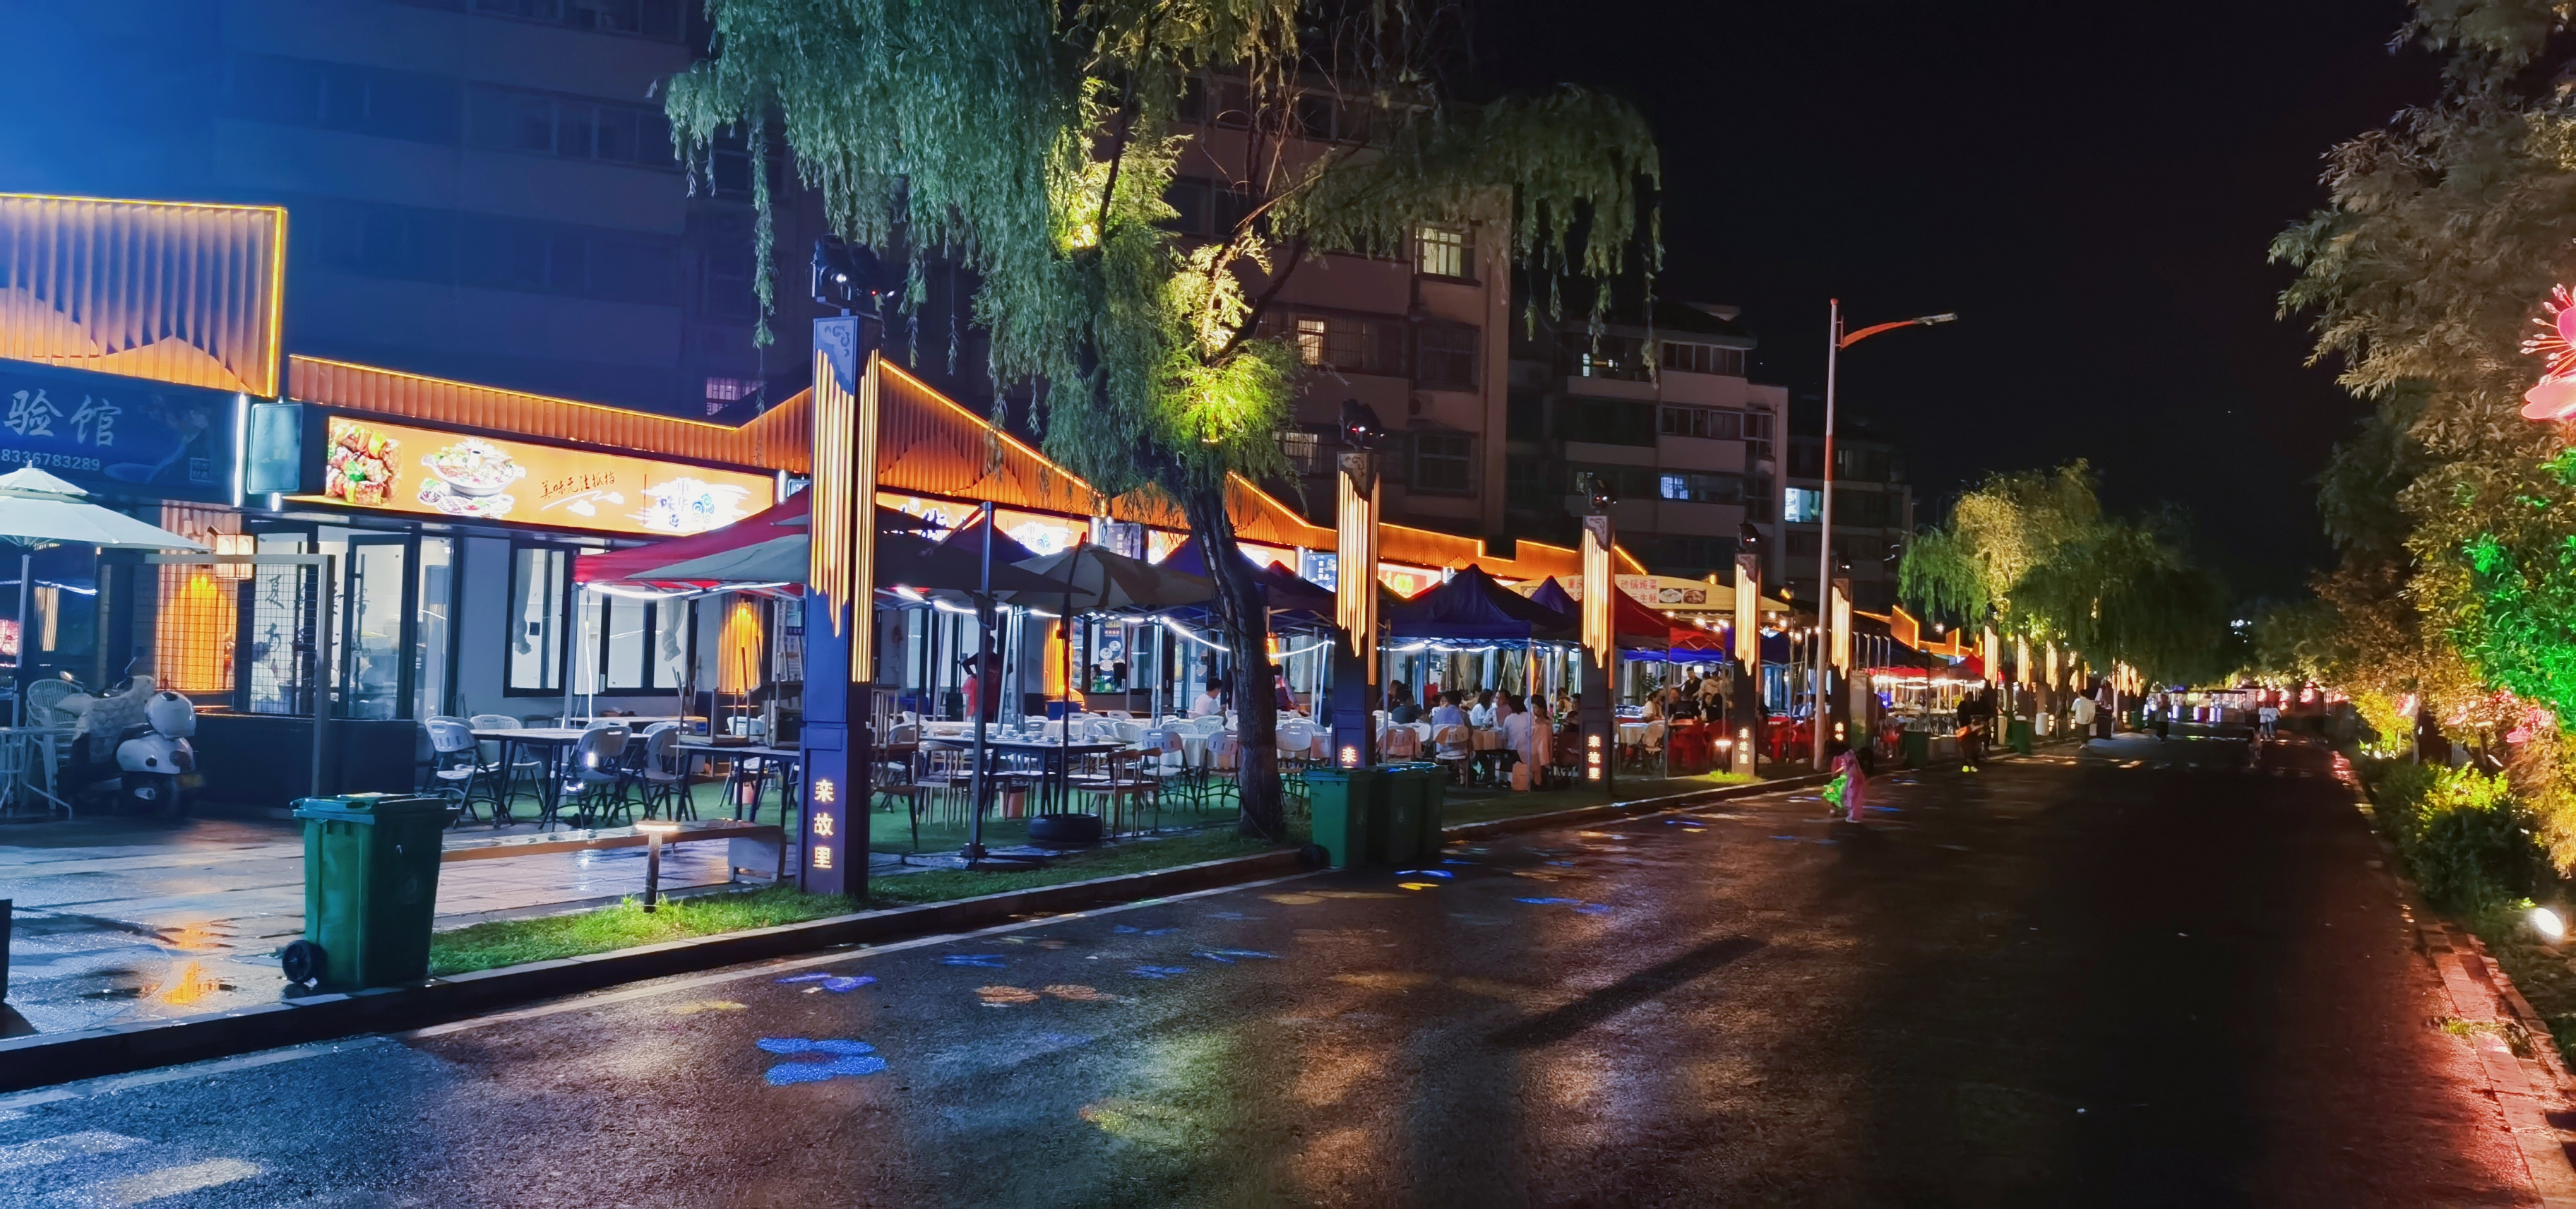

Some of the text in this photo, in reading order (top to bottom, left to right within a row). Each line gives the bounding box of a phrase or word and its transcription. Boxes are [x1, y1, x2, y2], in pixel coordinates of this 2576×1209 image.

[3, 388, 122, 447] 验馆
[1, 448, 100, 471] 8336783289
[539, 470, 615, 501] 美味无法抵挡
[813, 778, 835, 869] 栾故里
